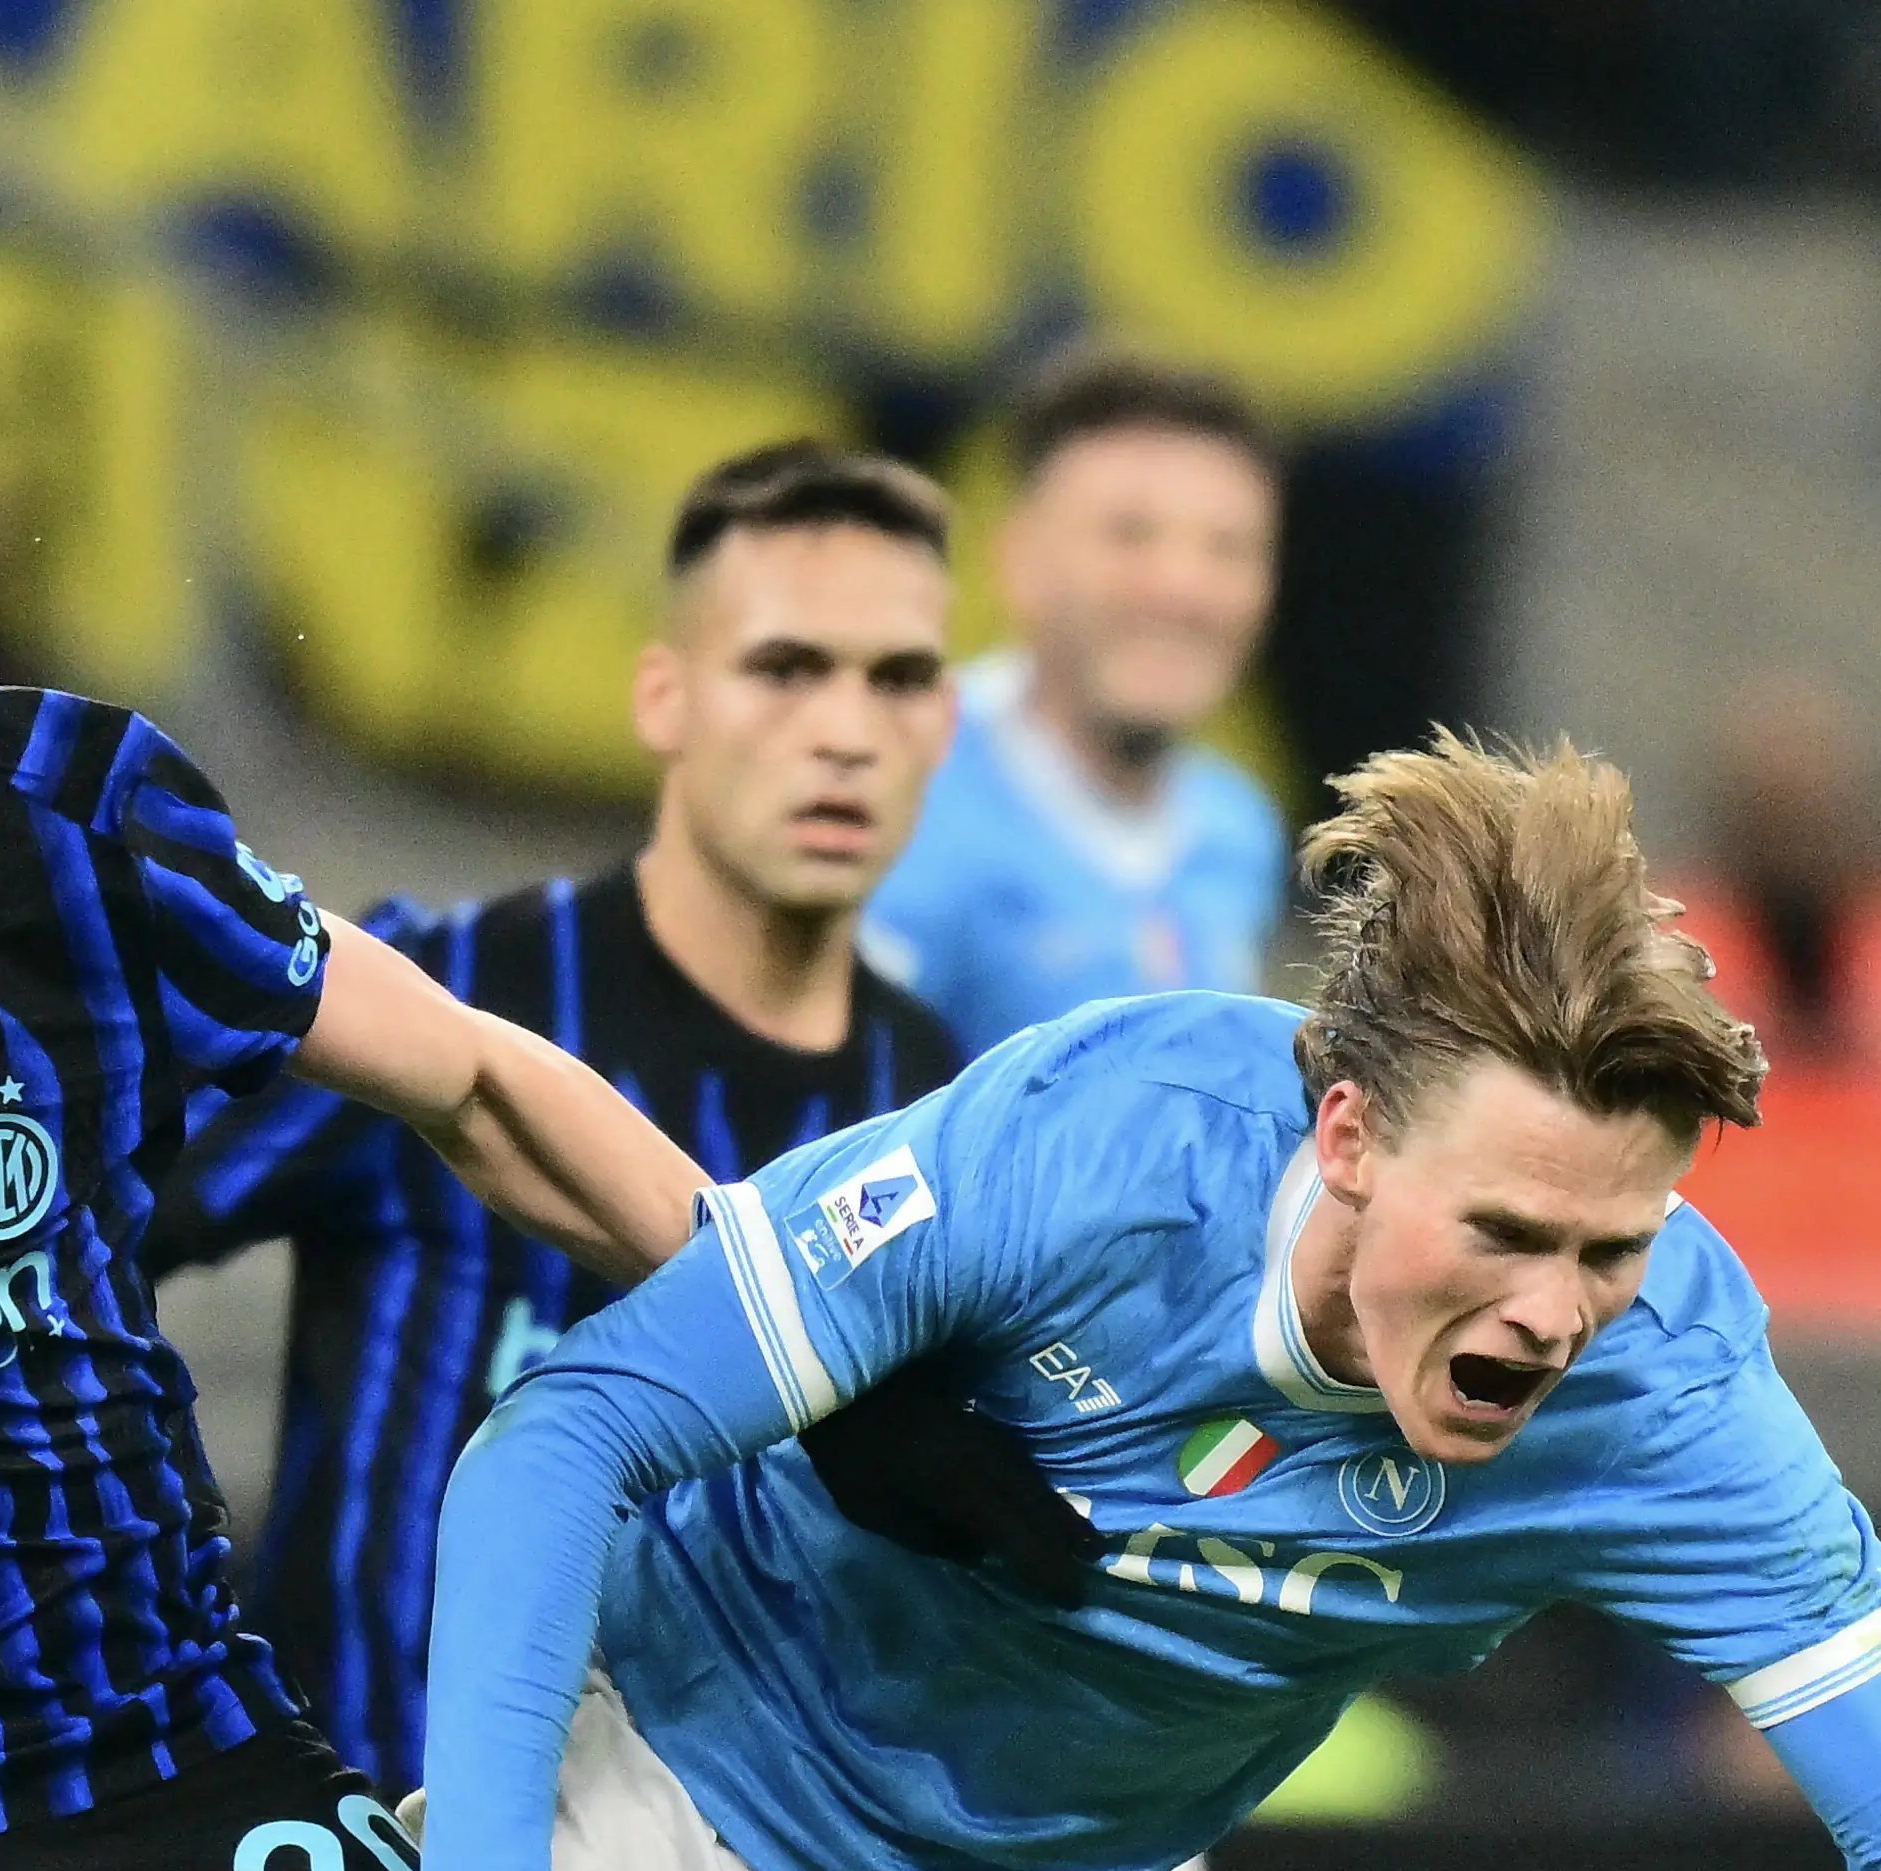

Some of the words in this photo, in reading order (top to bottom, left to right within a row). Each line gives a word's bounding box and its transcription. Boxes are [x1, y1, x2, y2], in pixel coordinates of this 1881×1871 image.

[834, 1195, 860, 1237] SERIE
[852, 1237, 865, 1250] A
[1029, 1341, 1122, 1413] EA7
[1363, 1455, 1420, 1512] N
